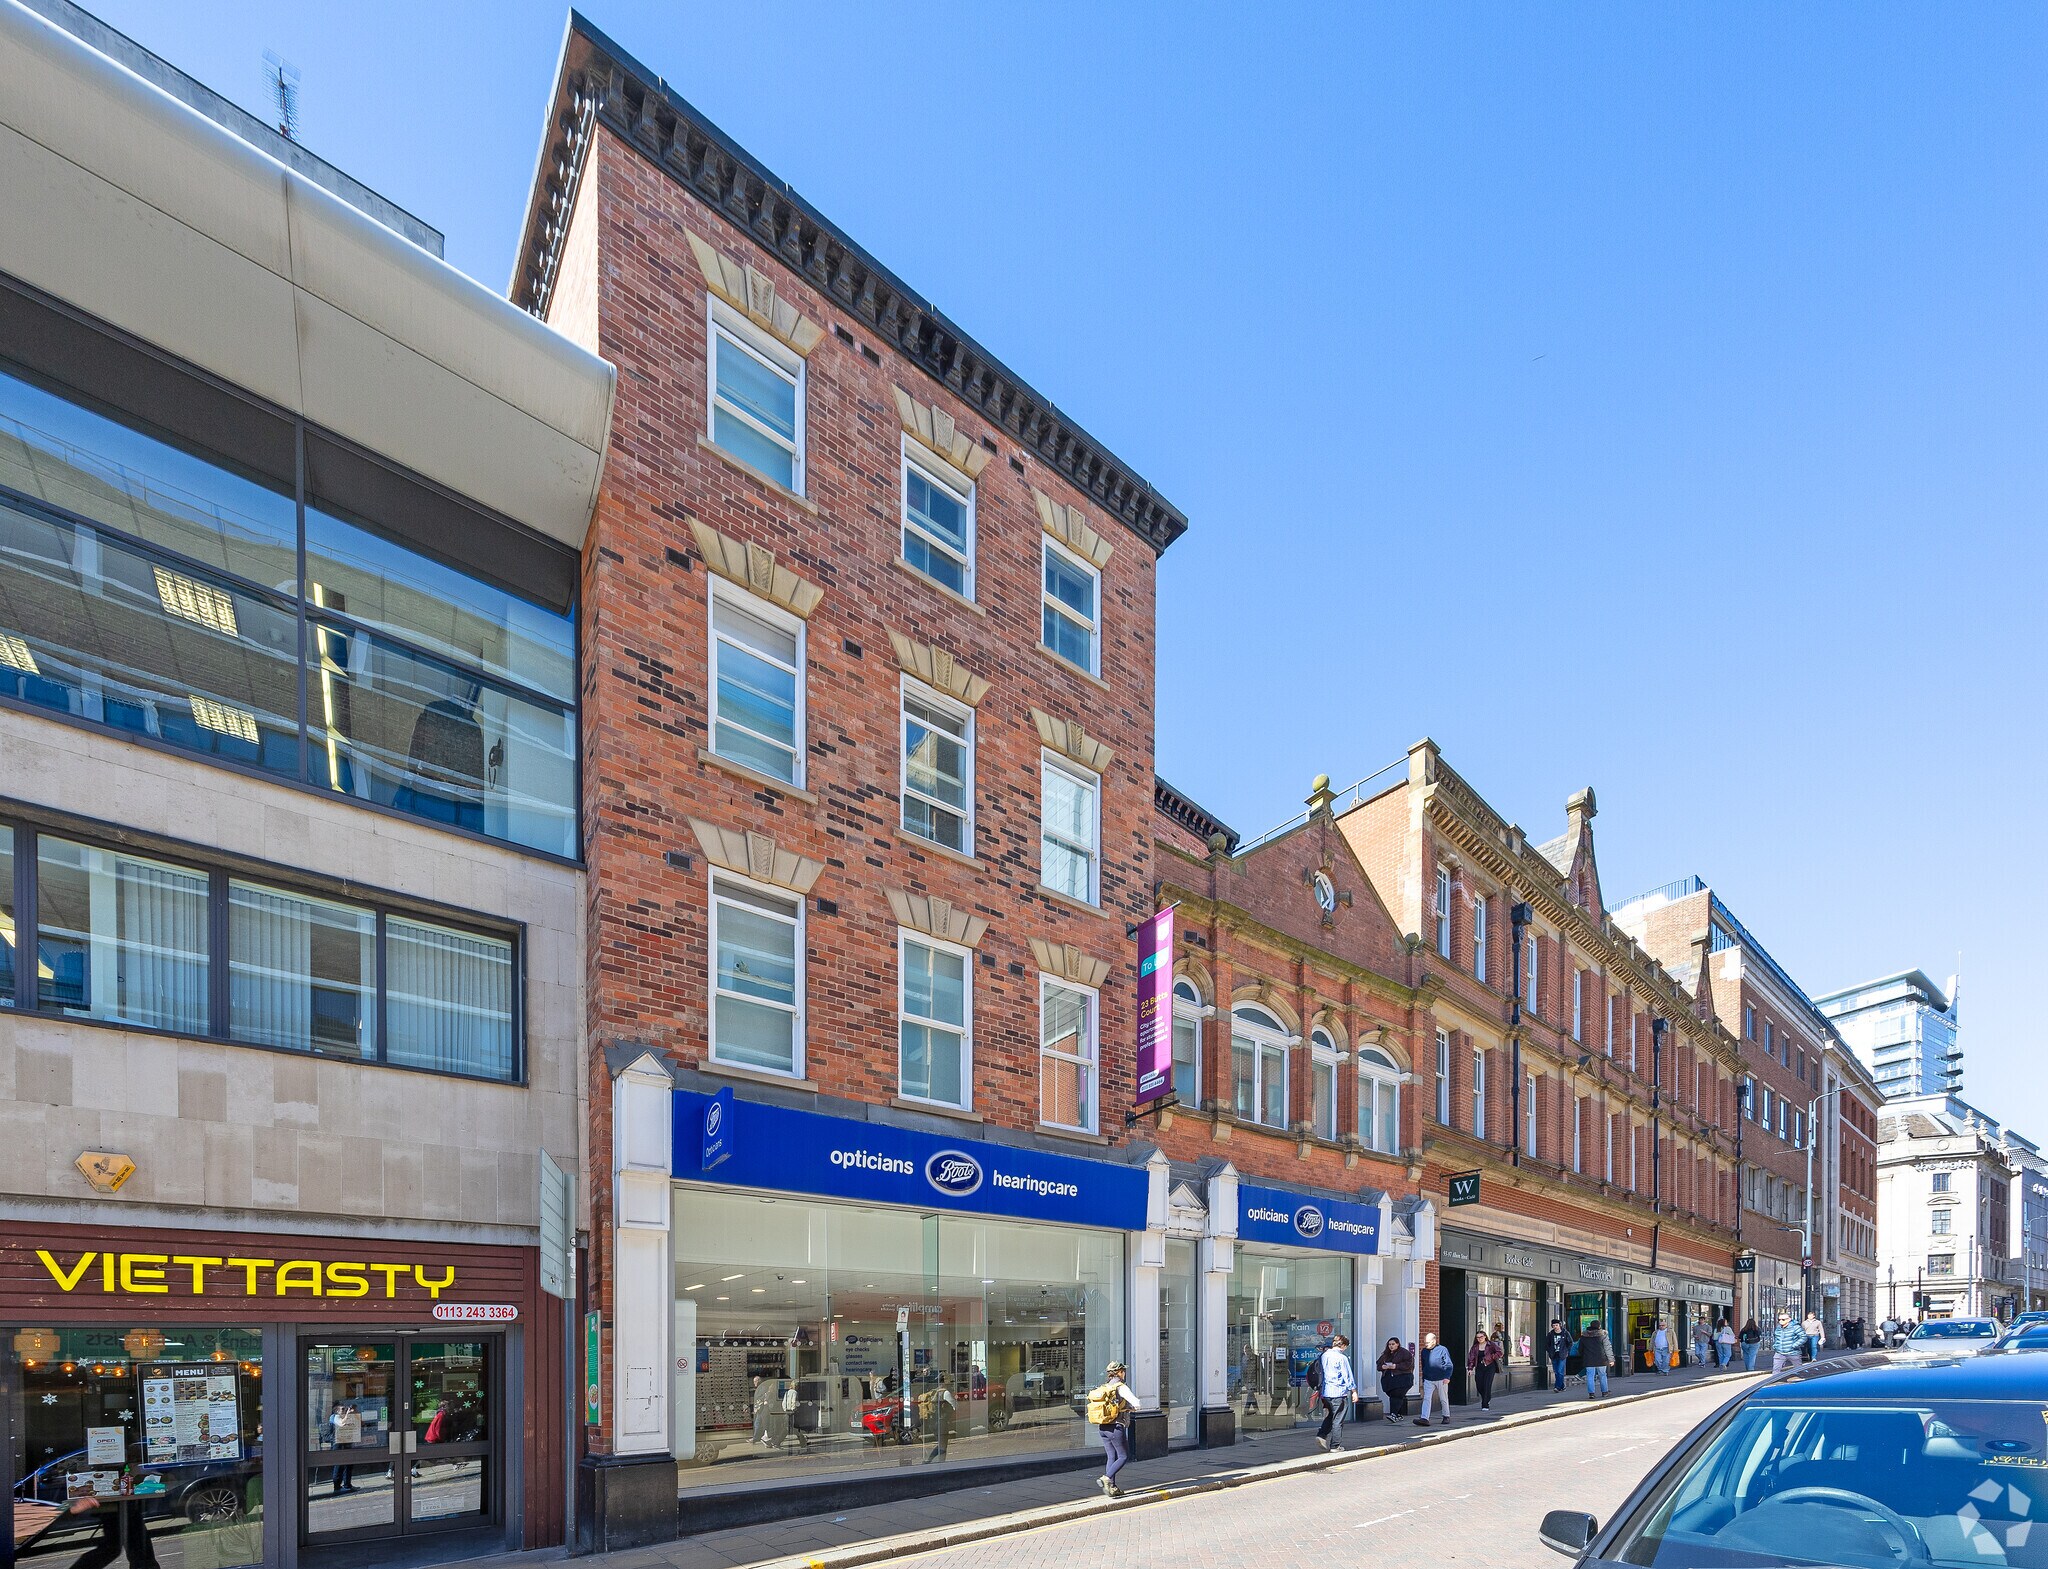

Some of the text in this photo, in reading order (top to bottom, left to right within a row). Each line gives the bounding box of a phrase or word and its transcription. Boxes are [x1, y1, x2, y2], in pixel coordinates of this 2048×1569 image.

[1140, 991, 1169, 1010] 23 Butts
[1140, 1003, 1161, 1019] Court
[1140, 1022, 1150, 1030] City
[705, 1139, 722, 1158] Opticians
[830, 1149, 1078, 1197] opticians Boots hearingcare
[1938, 1159, 1975, 1171] light
[1454, 1179, 1475, 1195] W
[1248, 1208, 1375, 1236] opticians Boots hearingcare
[1505, 1253, 1521, 1266] Books
[1738, 1259, 1753, 1267] W
[35, 1250, 455, 1299] VIETTASTY
[1578, 1263, 1613, 1282] Waterstones
[1649, 1276, 1675, 1292] Waterstones
[436, 1306, 515, 1319] 0113 243 3364
[1291, 1322, 1310, 1331] Rain
[1291, 1350, 1299, 1359] &
